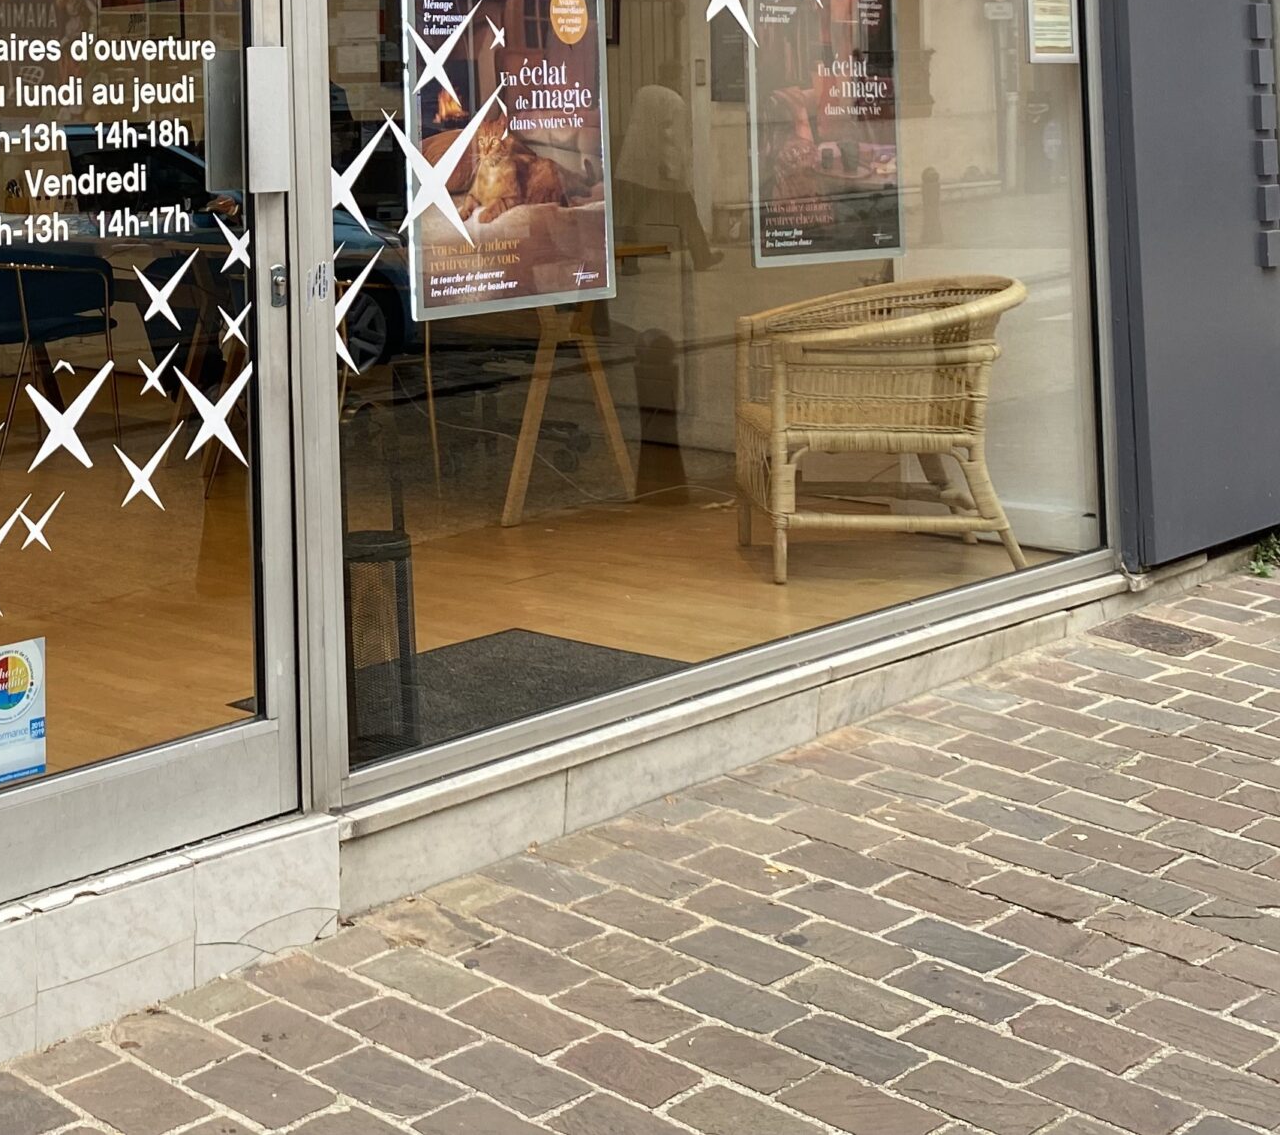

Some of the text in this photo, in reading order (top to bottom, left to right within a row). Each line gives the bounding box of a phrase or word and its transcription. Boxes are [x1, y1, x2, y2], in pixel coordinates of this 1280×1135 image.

[423, 0, 453, 12] Ménage
[70, 32, 216, 61] d'ouverture
[500, 58, 567, 86] Un éclat
[832, 53, 869, 78] éclat
[16, 76, 83, 107] lundi
[92, 81, 124, 105] au
[132, 75, 195, 112] jeudi
[516, 82, 592, 114] de magie
[829, 75, 887, 103] de magie
[94, 118, 189, 150] 14h-18h
[510, 114, 583, 130] dans votre vie
[24, 163, 147, 198] Vendredi
[96, 204, 190, 238] 14h-17h
